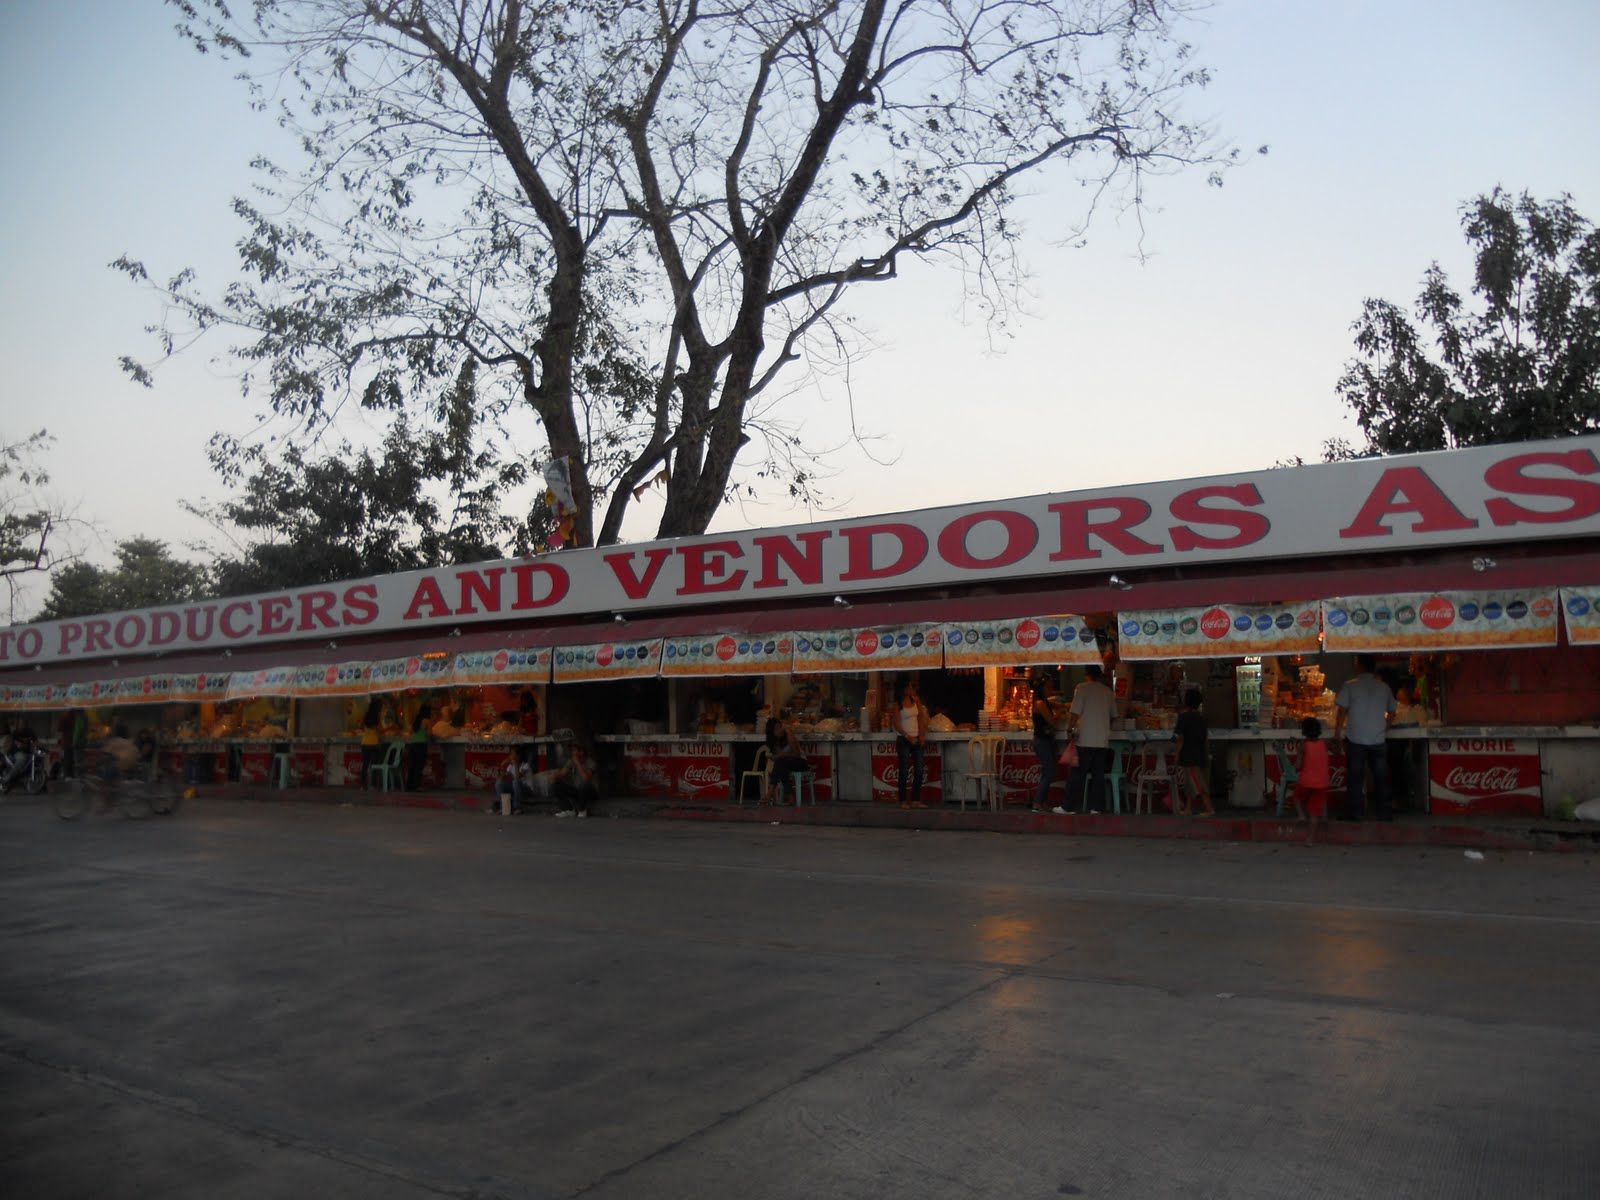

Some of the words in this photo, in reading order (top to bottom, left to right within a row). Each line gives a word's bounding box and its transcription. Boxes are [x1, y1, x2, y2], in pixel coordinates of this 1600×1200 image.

[57, 583, 380, 655] PRODUCERS
[402, 560, 571, 620] AND
[603, 482, 1271, 600] VENDORS
[1339, 448, 1600, 539] AS
[1457, 738, 1516, 752] NORIE
[684, 764, 721, 782] Coca-Cola
[1445, 766, 1520, 791] Coca-Cola
